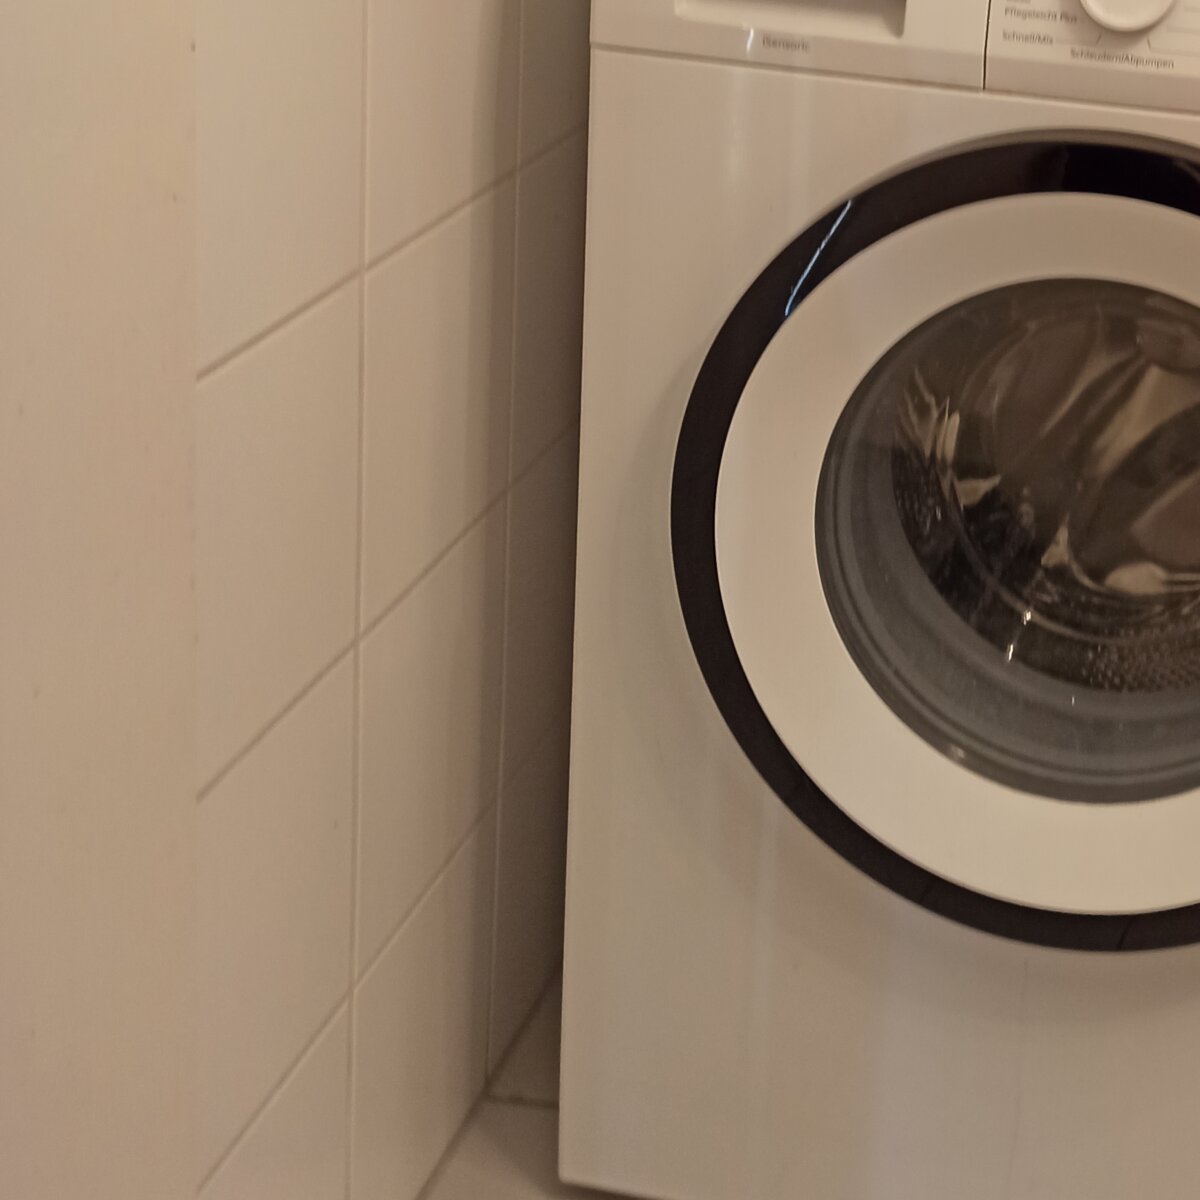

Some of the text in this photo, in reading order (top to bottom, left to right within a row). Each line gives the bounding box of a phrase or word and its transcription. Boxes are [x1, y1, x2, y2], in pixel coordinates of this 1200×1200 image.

[1005, 6, 1077, 24] Pflegeleicht Plus
[1070, 47, 1175, 70] Schleudern/Abpumpen
